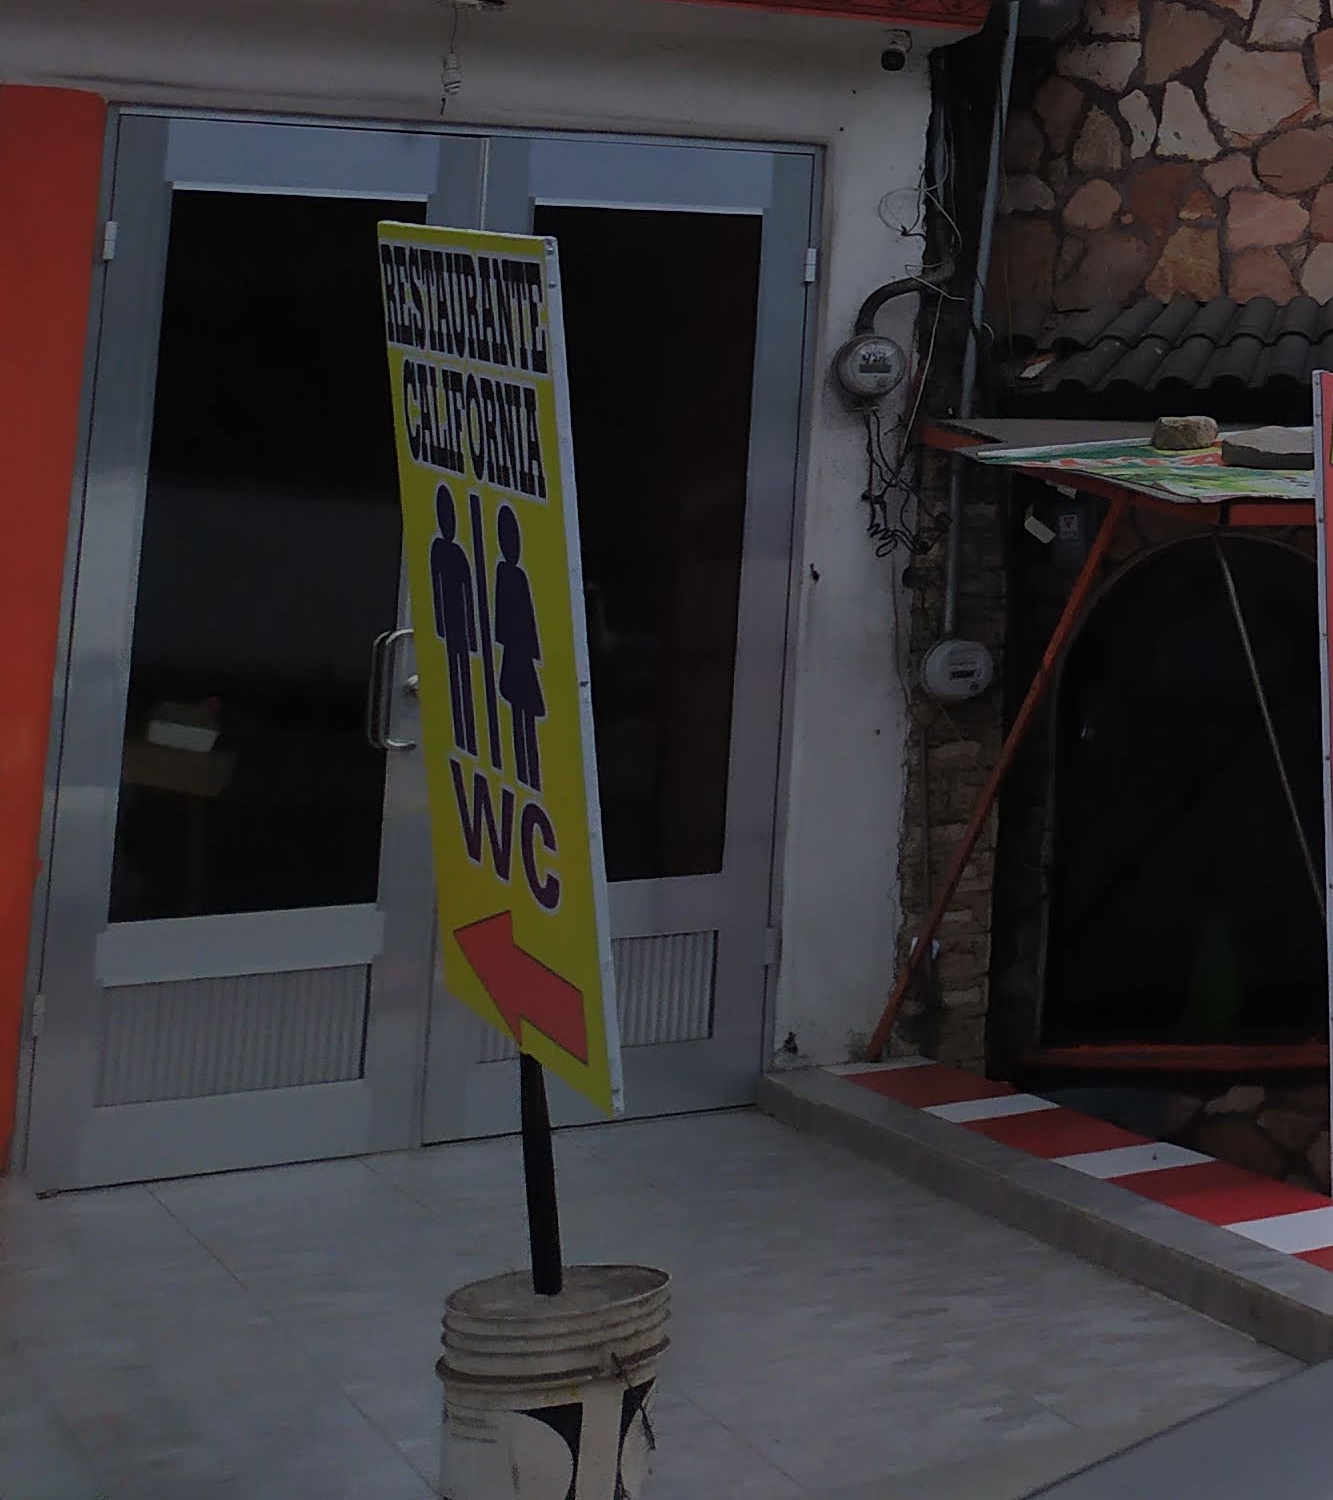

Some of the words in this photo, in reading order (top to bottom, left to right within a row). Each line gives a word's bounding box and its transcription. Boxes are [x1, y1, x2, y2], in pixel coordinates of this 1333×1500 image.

[380, 243, 547, 374] RESTAURANTE
[403, 358, 547, 500] CALIFORNIA
[449, 757, 560, 910] WC
